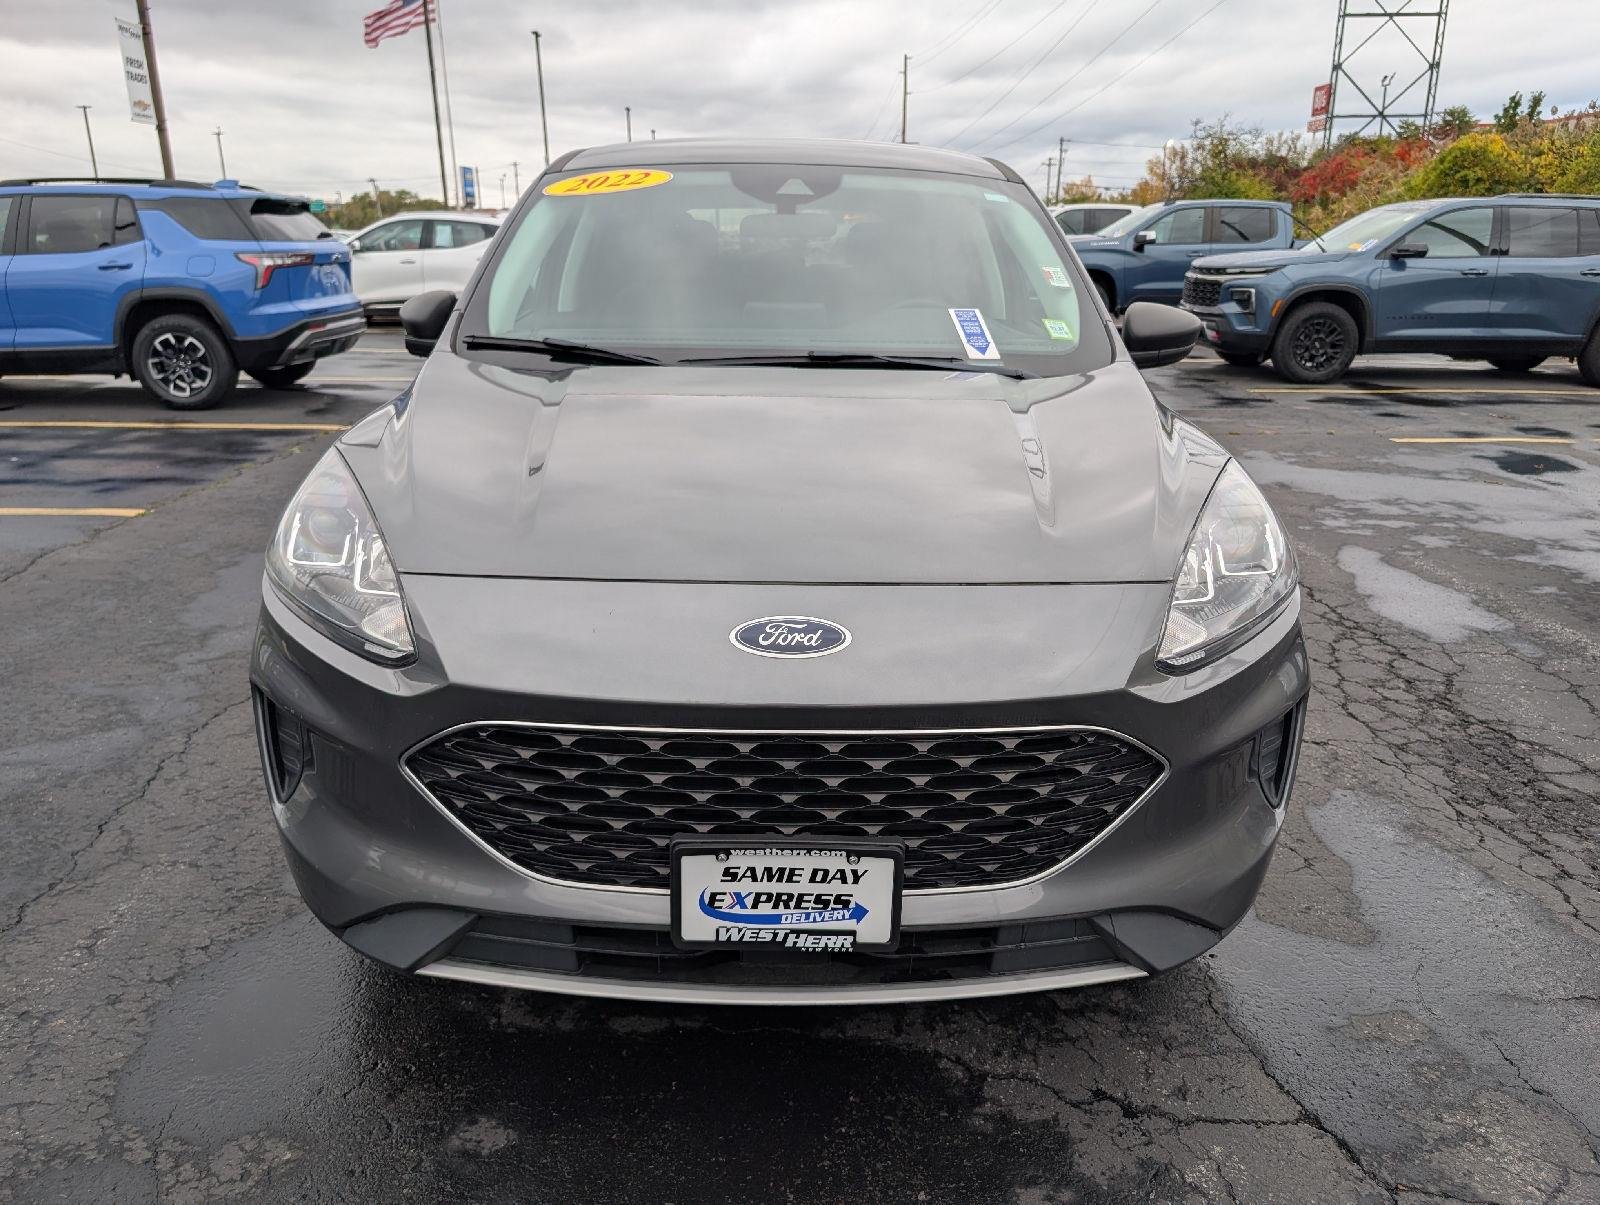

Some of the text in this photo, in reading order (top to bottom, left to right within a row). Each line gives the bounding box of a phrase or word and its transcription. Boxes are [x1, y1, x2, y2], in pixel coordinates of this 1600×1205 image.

[563, 171, 652, 194] 2022
[758, 622, 823, 646] Ford
[730, 848, 847, 857] westherr.com
[720, 866, 869, 885] SAME DAY
[707, 891, 854, 910] EXPRESS
[780, 909, 854, 925] DELIVERY
